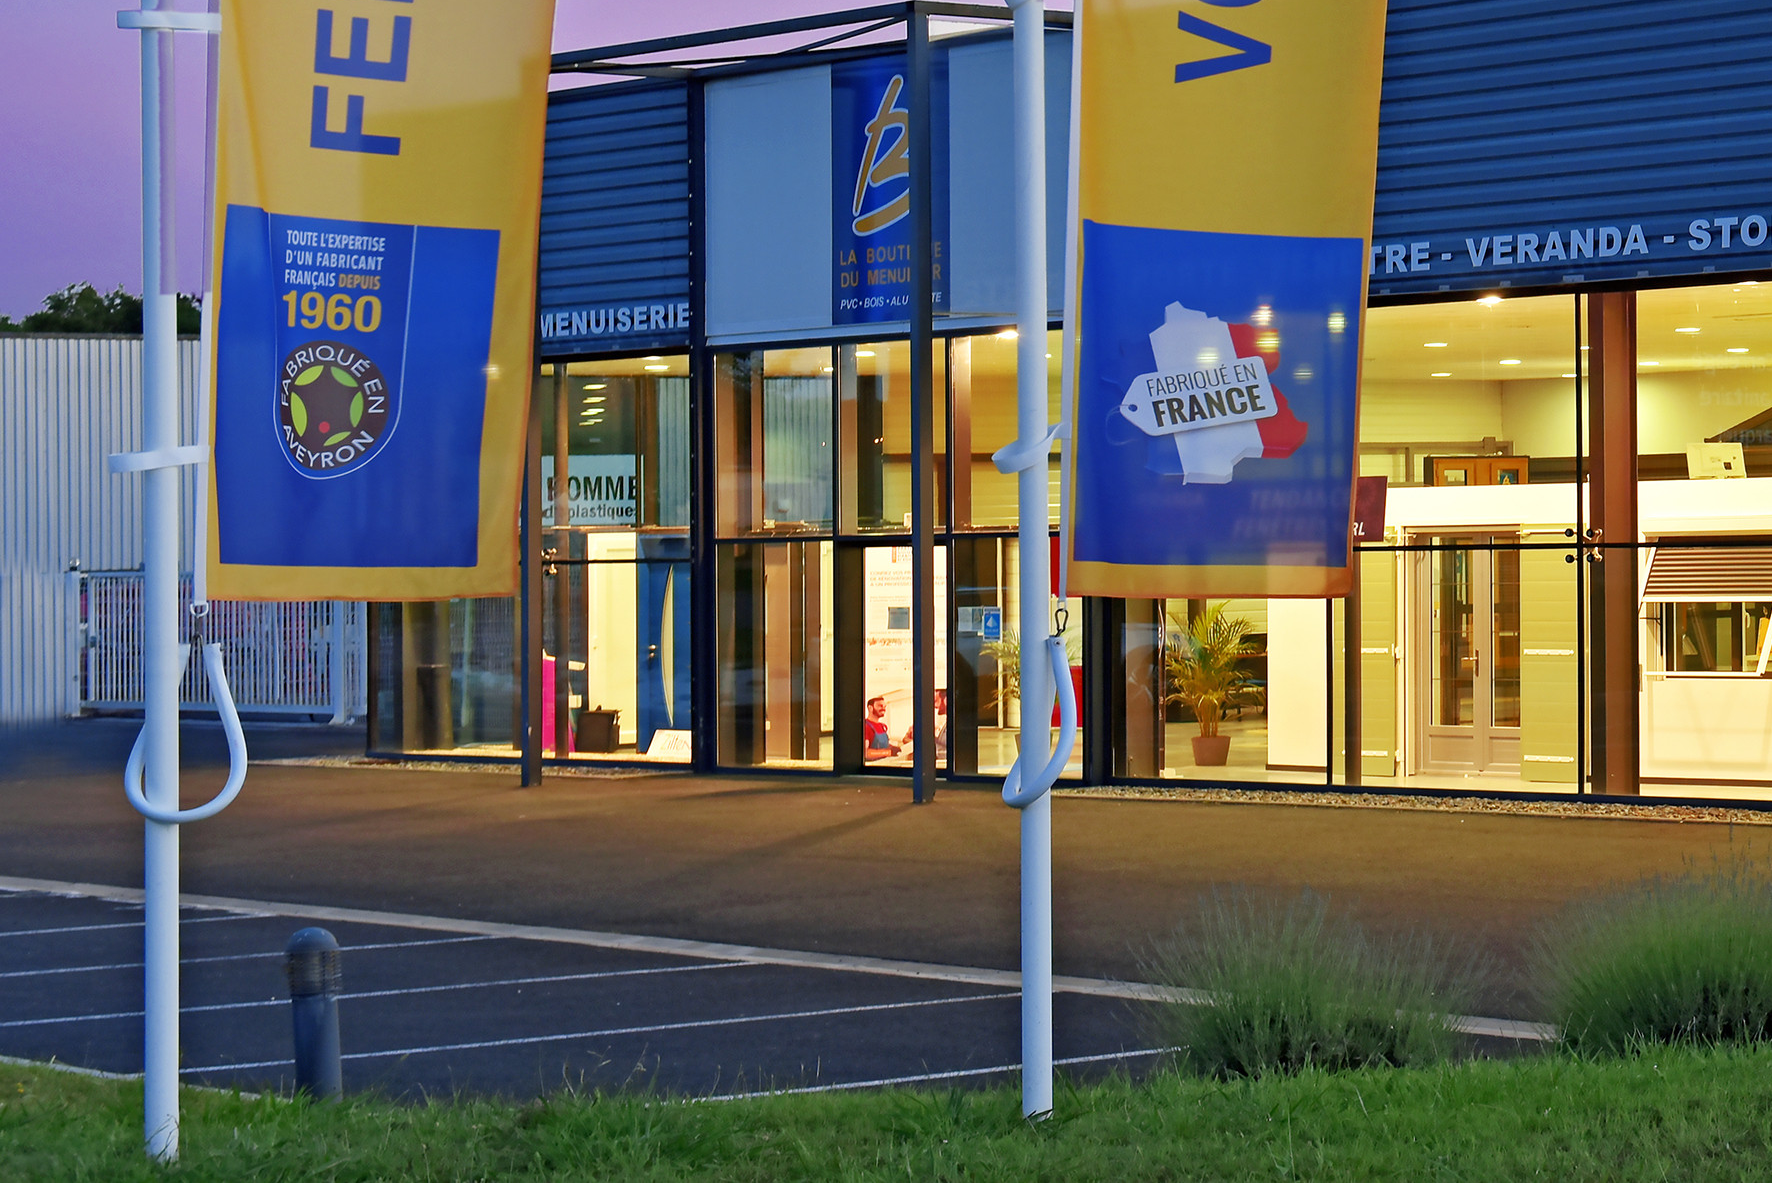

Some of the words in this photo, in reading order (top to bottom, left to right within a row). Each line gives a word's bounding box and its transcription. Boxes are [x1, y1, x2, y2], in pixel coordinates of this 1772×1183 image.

[287, 229, 319, 247] TOUTE
[840, 249, 857, 266] LA
[867, 241, 942, 264] BOUTIE
[1466, 224, 1649, 267] VERANDA
[316, 252, 384, 271] FABRICANT
[284, 269, 336, 290] FRANÇAIS
[338, 273, 381, 290] DEPUIS
[841, 271, 859, 288] DU
[282, 289, 382, 333] 1960
[541, 302, 690, 339] MENUISERIE
[280, 344, 371, 407] FABRIQUÉ
[363, 378, 386, 415] EN
[1146, 364, 1231, 397] FABRIQUÉ
[1234, 363, 1258, 383] EN
[1151, 384, 1266, 428] FRANCE
[283, 424, 375, 469] AVEYRON
